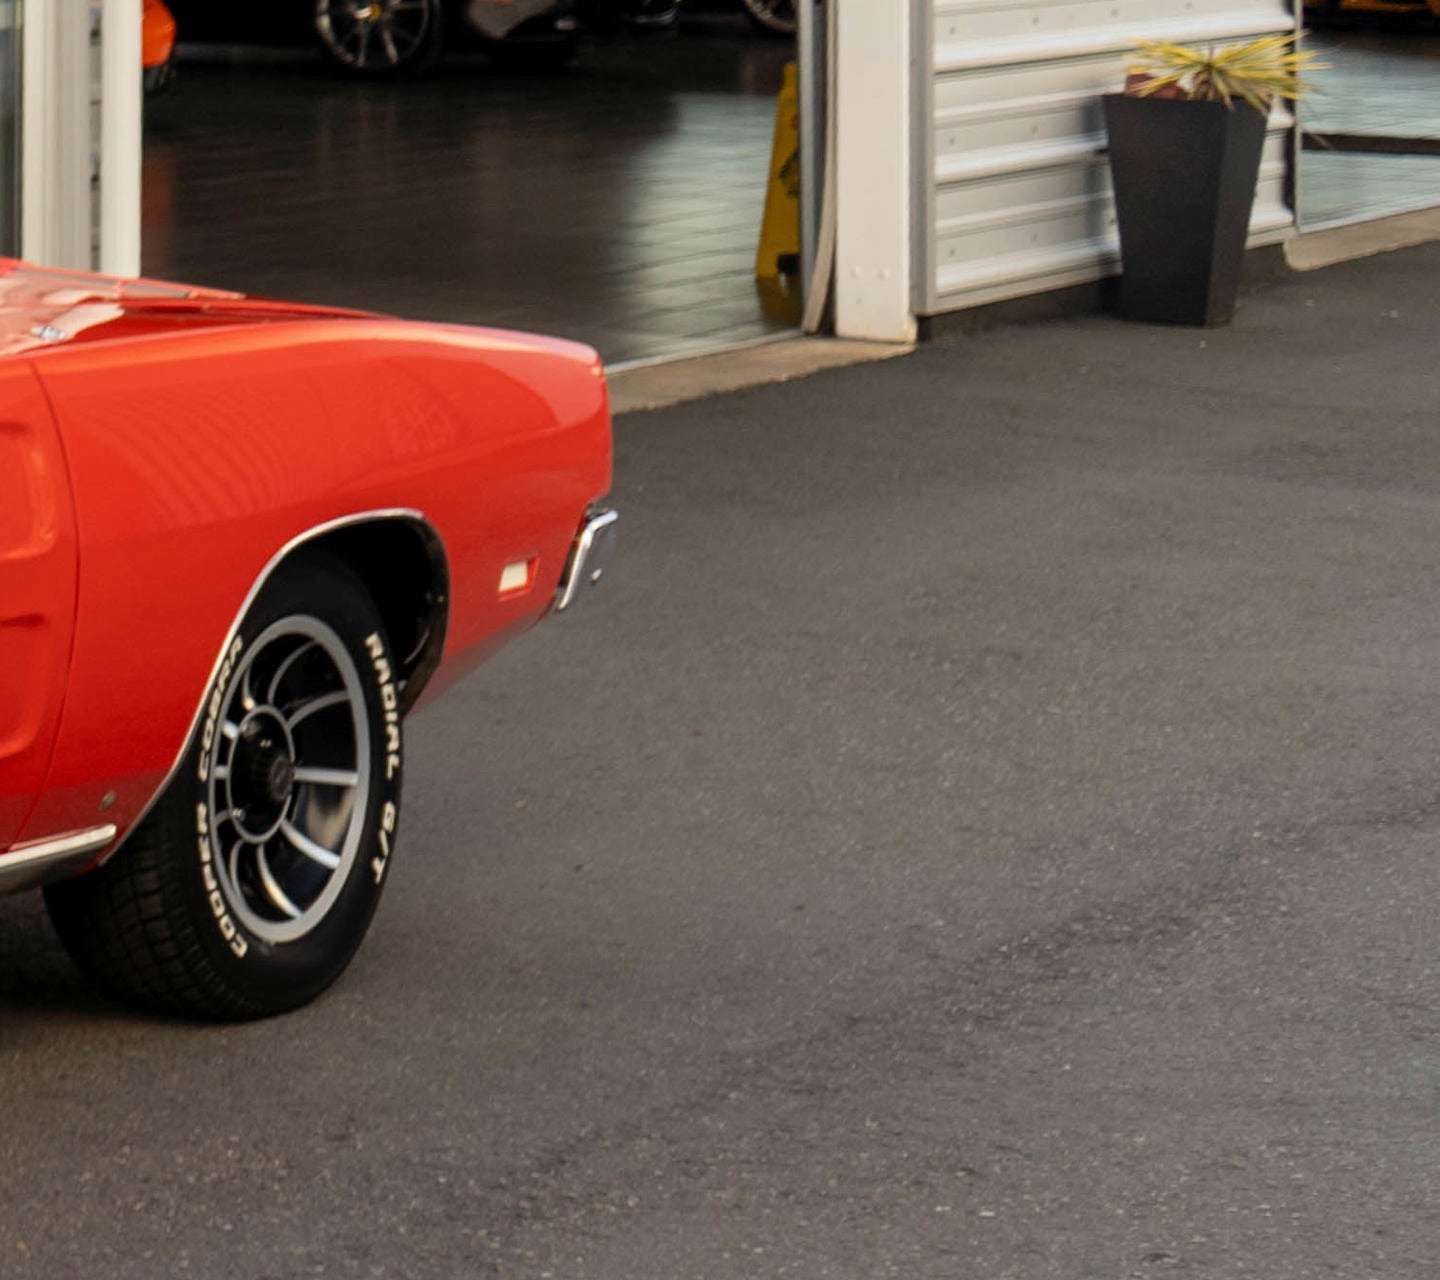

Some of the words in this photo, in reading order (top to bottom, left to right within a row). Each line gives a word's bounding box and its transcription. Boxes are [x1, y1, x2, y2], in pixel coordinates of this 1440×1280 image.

[198, 634, 243, 782] COBRA
[365, 632, 400, 780] RADIAL
[196, 801, 248, 958] COOPER
